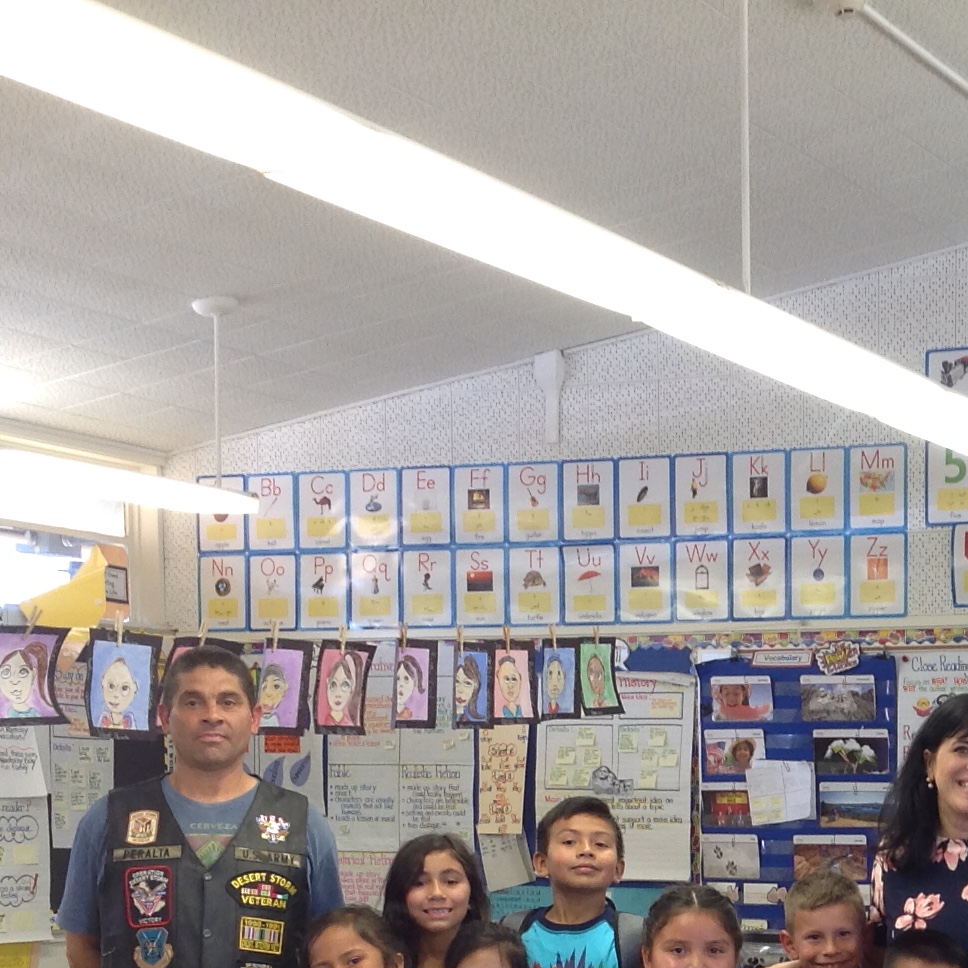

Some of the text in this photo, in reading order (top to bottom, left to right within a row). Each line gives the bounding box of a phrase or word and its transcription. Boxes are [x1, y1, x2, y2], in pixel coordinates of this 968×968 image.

[750, 456, 769, 475] Kk
[810, 452, 825, 472] Ll
[861, 450, 894, 469] Mm
[417, 471, 435, 489] Ee
[470, 469, 490, 488] Ff
[519, 466, 546, 494] Gg
[576, 464, 600, 483] Hh
[639, 461, 649, 481] Ii
[692, 458, 708, 487] Jj
[261, 478, 281, 496] Bb
[311, 476, 333, 494] Cc
[362, 473, 386, 492] Dd
[635, 546, 655, 565] Vv
[686, 544, 718, 563] Ww
[749, 541, 769, 561] Xx
[808, 539, 828, 567] Yy
[867, 537, 888, 557] Zz
[261, 558, 285, 576] Oo
[418, 553, 436, 572] Rr
[470, 551, 489, 570] Ss
[525, 550, 544, 568] Tt
[576, 548, 601, 567] Uu
[212, 559, 233, 576] Nn
[314, 556, 333, 582] Pp
[362, 554, 391, 581] Qq
[912, 656, 937, 672] Close
[190, 822, 238, 830] CERVEZA
[123, 848, 170, 859] PERALTA
[269, 853, 295, 865] ARMY
[231, 873, 298, 895] DESERT STORM
[241, 895, 287, 908] VETERAN
